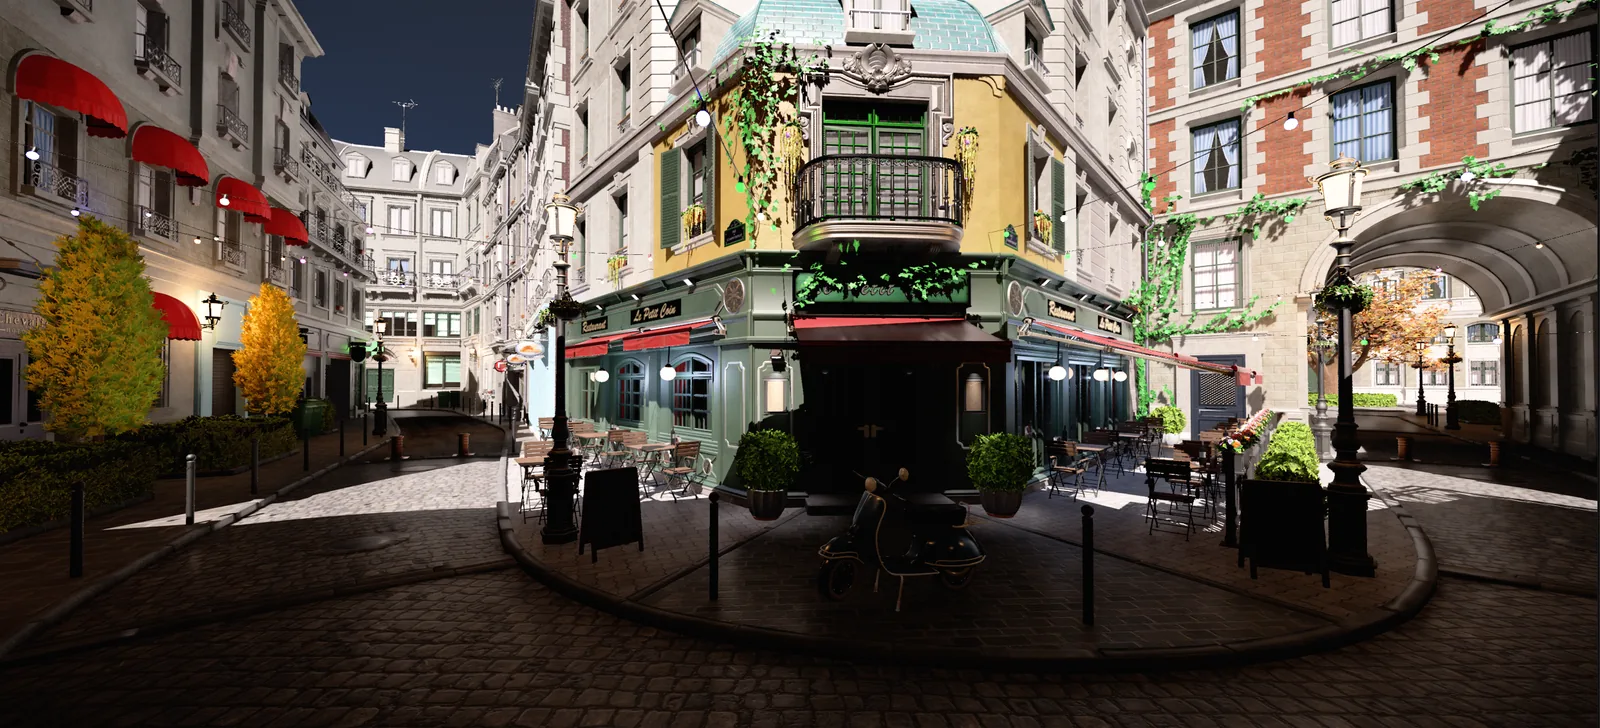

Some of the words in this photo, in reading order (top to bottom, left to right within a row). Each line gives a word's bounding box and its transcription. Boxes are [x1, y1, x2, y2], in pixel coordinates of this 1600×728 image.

[855, 283, 895, 296] etit
[0, 311, 48, 327] hevali
[633, 310, 642, 322] Le
[643, 307, 659, 321] Petit
[659, 303, 677, 318] Coin
